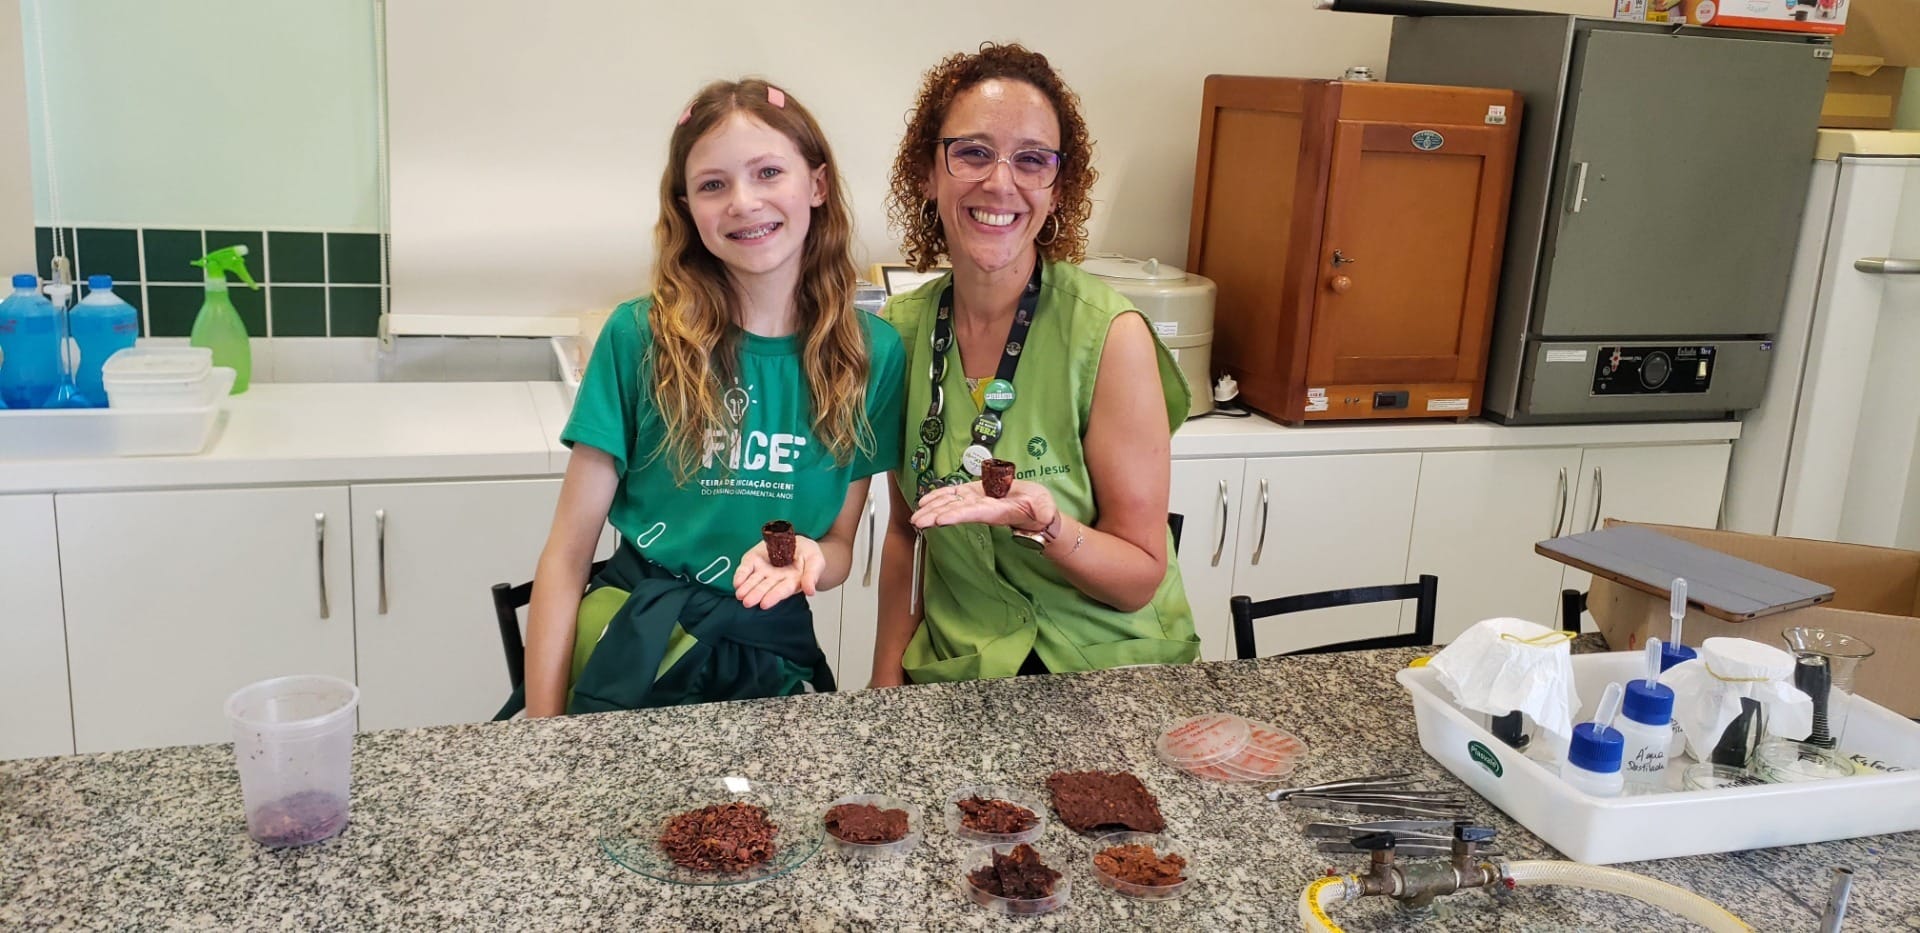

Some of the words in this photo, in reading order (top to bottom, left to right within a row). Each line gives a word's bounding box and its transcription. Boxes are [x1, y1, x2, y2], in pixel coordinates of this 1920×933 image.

[1016, 469, 1036, 479] om
[1040, 464, 1071, 476] Jesus
[724, 479, 735, 487] DE
